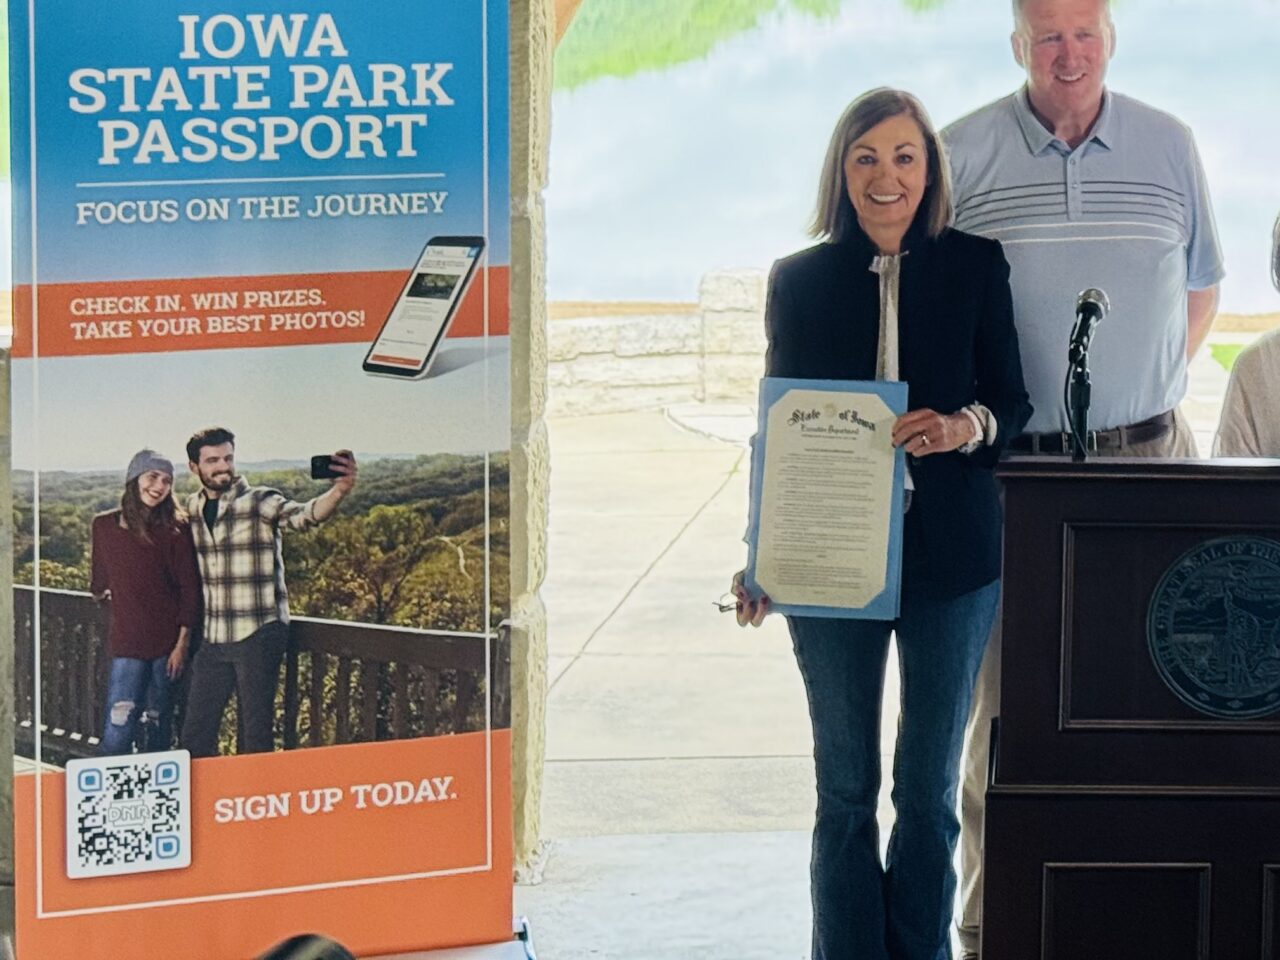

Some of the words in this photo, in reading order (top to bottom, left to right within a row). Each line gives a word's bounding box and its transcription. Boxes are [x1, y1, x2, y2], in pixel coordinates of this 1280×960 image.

[178, 13, 348, 60] IOWA
[68, 66, 271, 114] STATE
[289, 63, 455, 109] PARK
[98, 114, 428, 166] PASSPORT
[76, 199, 178, 225] FOCUS
[185, 197, 231, 222] ON
[238, 195, 300, 219] THE
[307, 191, 448, 217] JOURNEY
[70, 294, 151, 316] CHECK
[155, 294, 186, 314] IN.
[193, 291, 239, 311] WIN
[243, 288, 327, 308] PRIZES.
[71, 319, 133, 341] TAKE
[138, 316, 202, 338] YOUR
[206, 313, 264, 335] BEST
[269, 309, 366, 332] PHOTOS!
[787, 408, 821, 427] State
[1179, 546, 1222, 578] SEAL
[1224, 542, 1247, 556] OF
[108, 804, 151, 826] DNR
[214, 791, 290, 824] SIGN
[299, 787, 343, 815] UP
[350, 776, 458, 810] TODAY.
